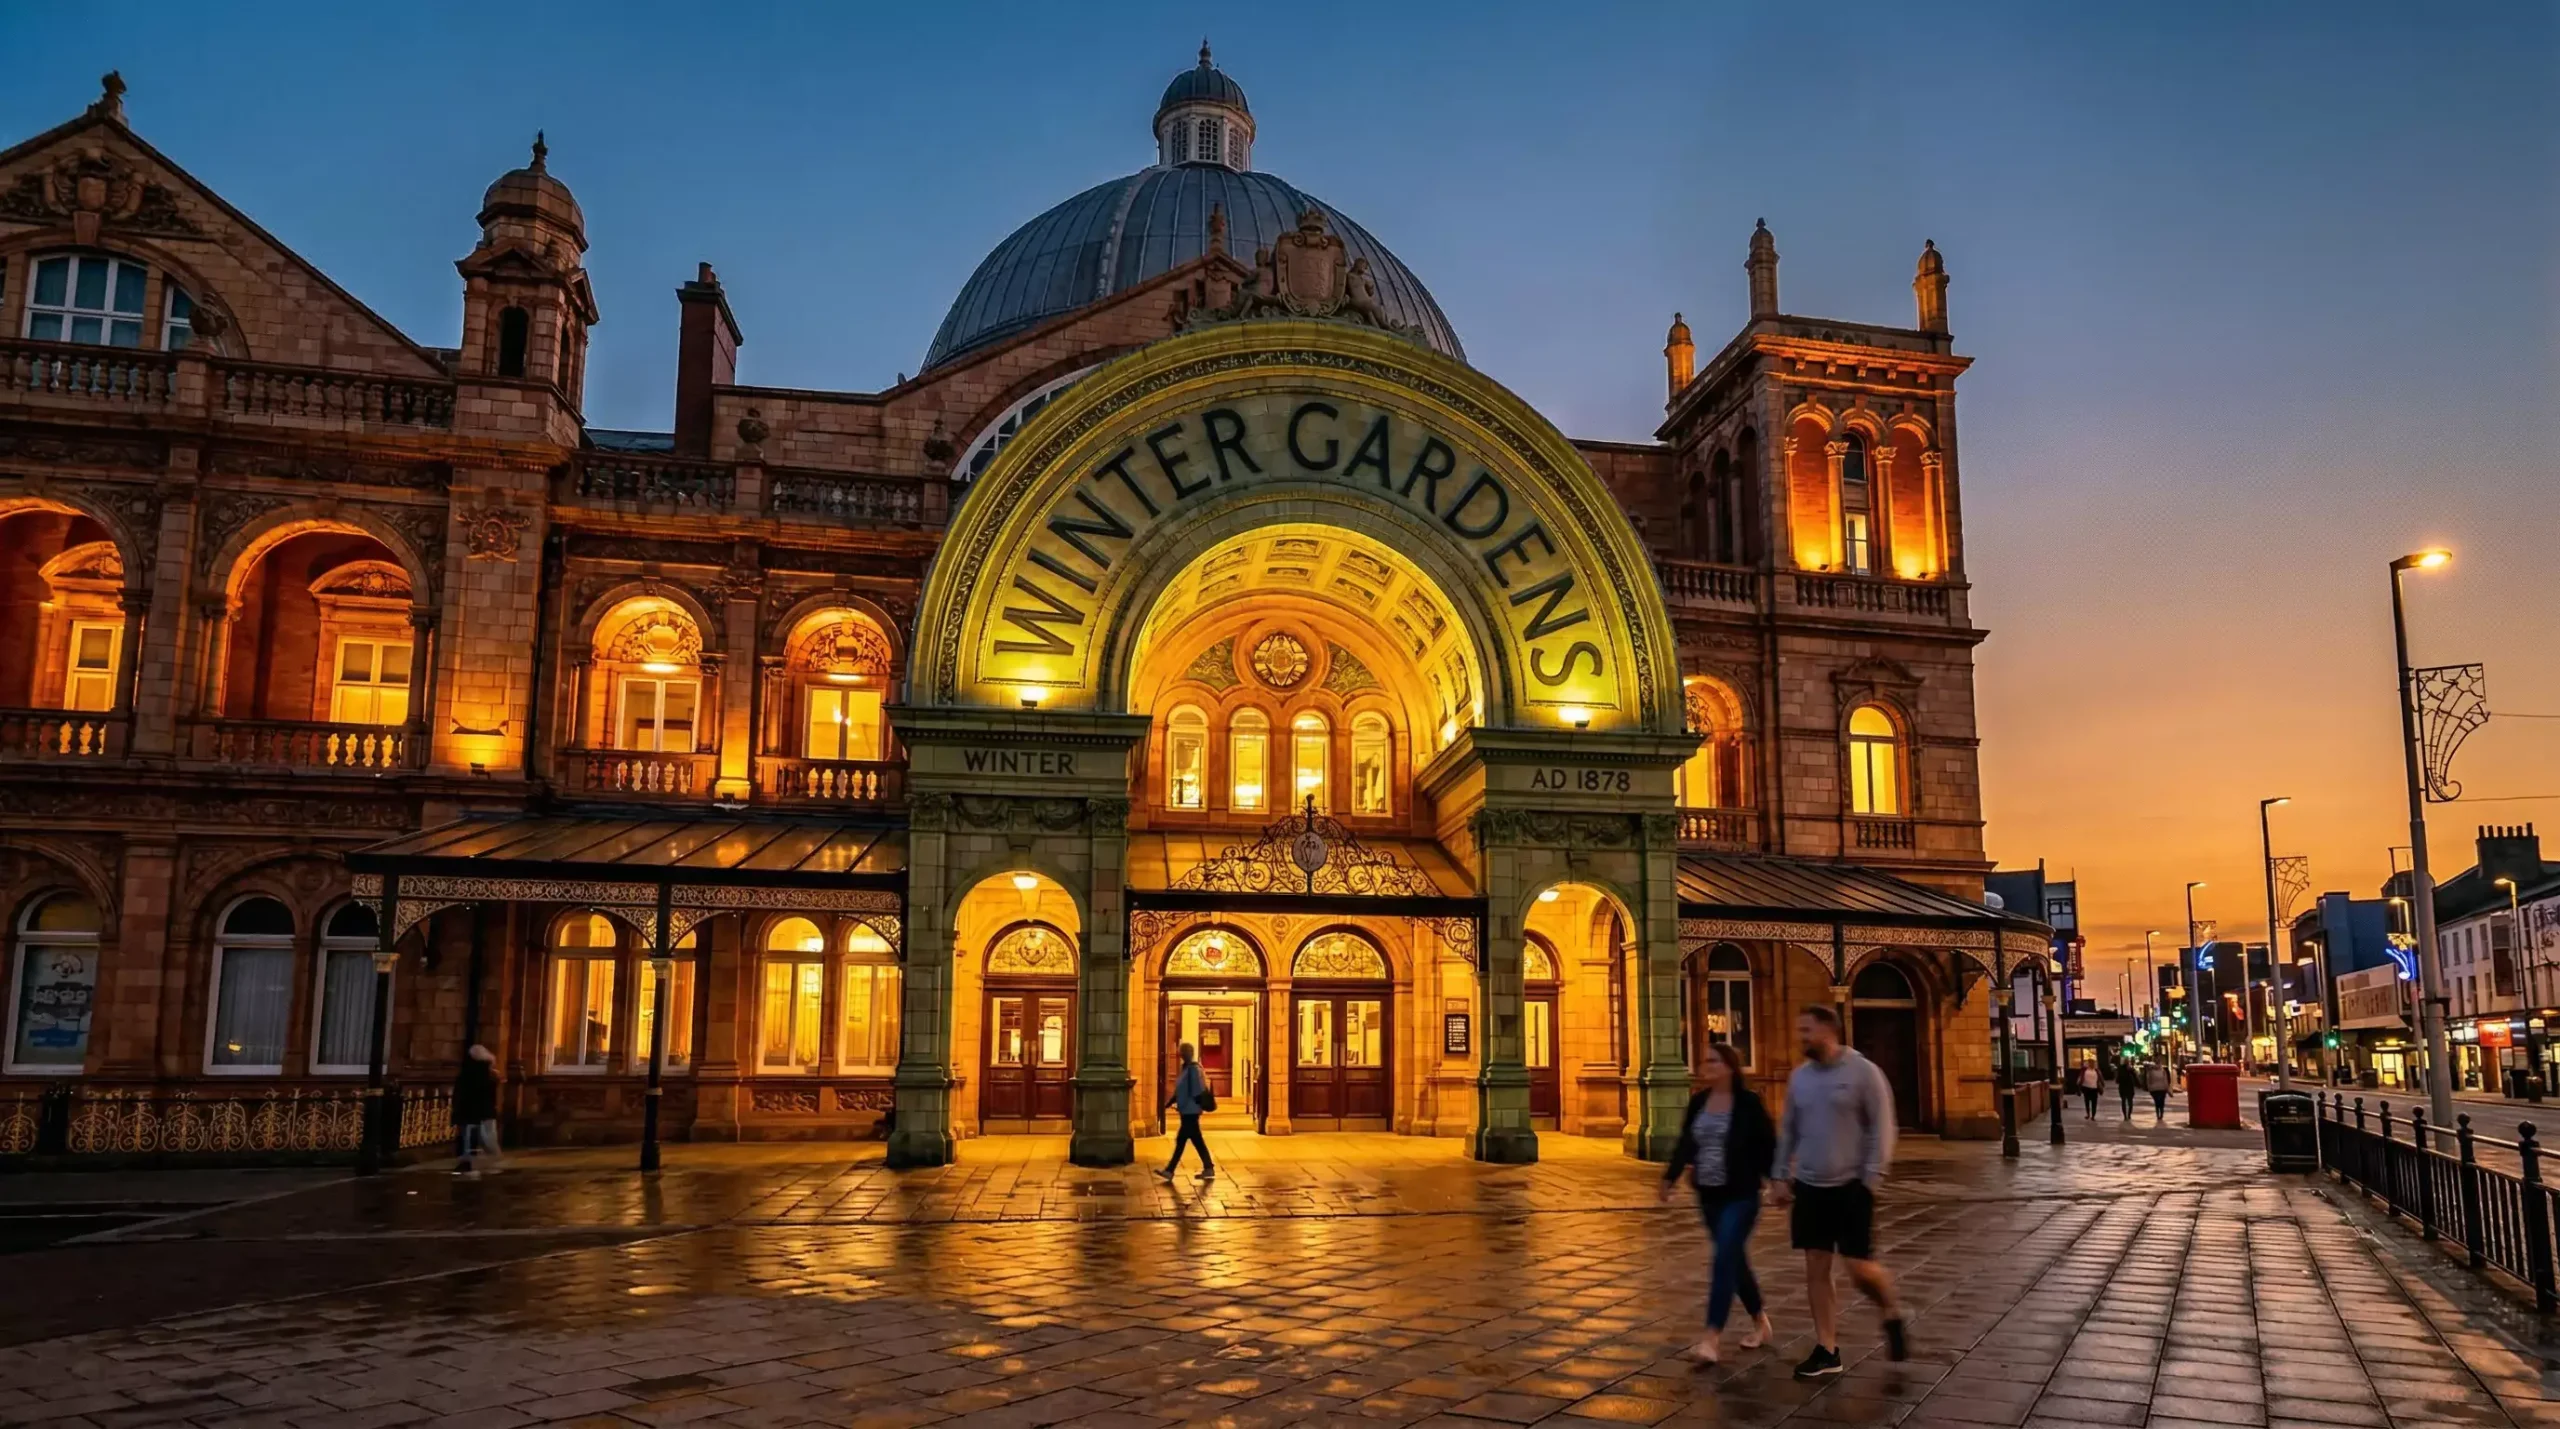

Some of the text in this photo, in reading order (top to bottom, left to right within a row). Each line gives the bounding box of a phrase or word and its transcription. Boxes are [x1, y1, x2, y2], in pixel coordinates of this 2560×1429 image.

[993, 402, 1604, 687] WINTER GARDENS
[963, 749, 1076, 775] WINTER
[1530, 767, 1631, 792] AD 1878
